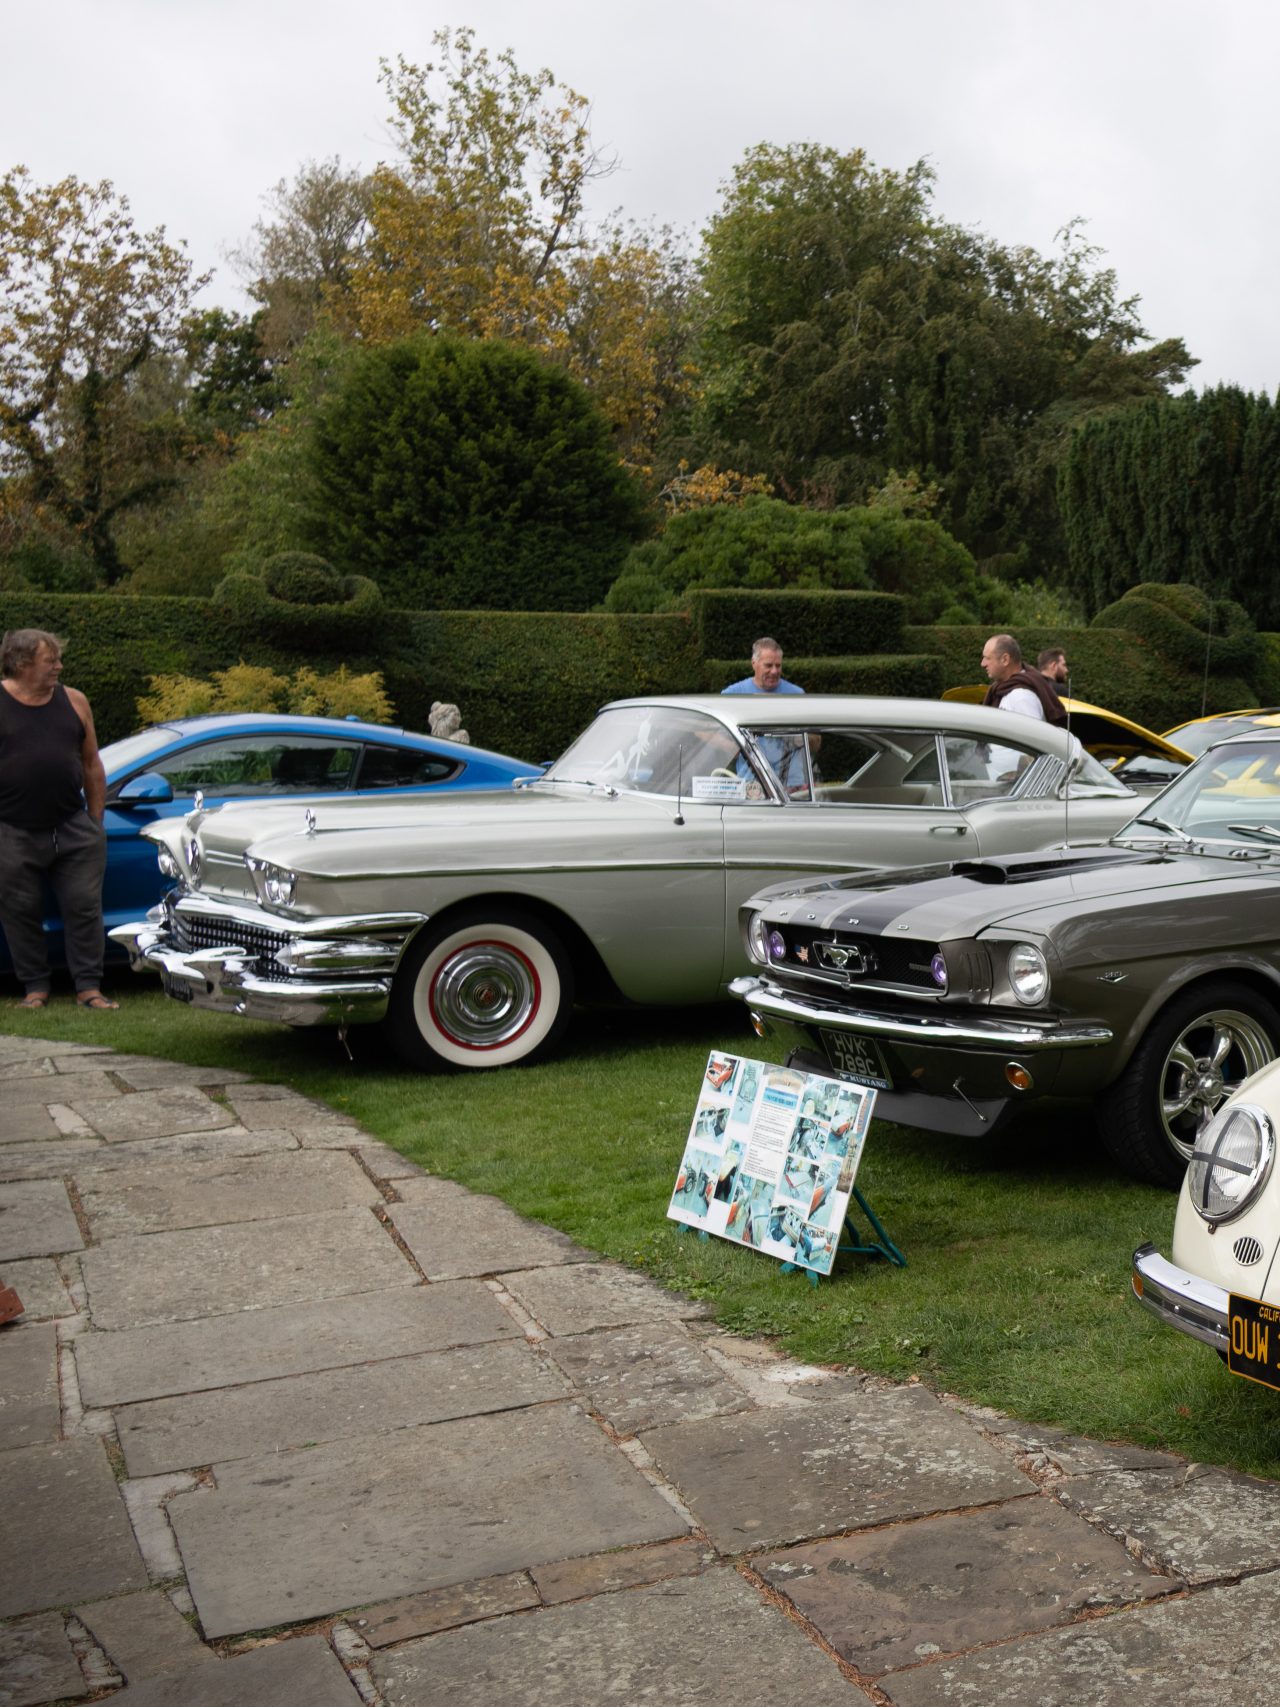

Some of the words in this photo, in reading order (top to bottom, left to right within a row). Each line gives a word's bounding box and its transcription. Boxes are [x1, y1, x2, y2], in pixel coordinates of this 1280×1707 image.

[832, 1032, 867, 1057] HVK
[834, 1050, 878, 1077] 789C
[849, 1074, 887, 1088] MUSTANG
[1232, 1314, 1269, 1365] OUW
